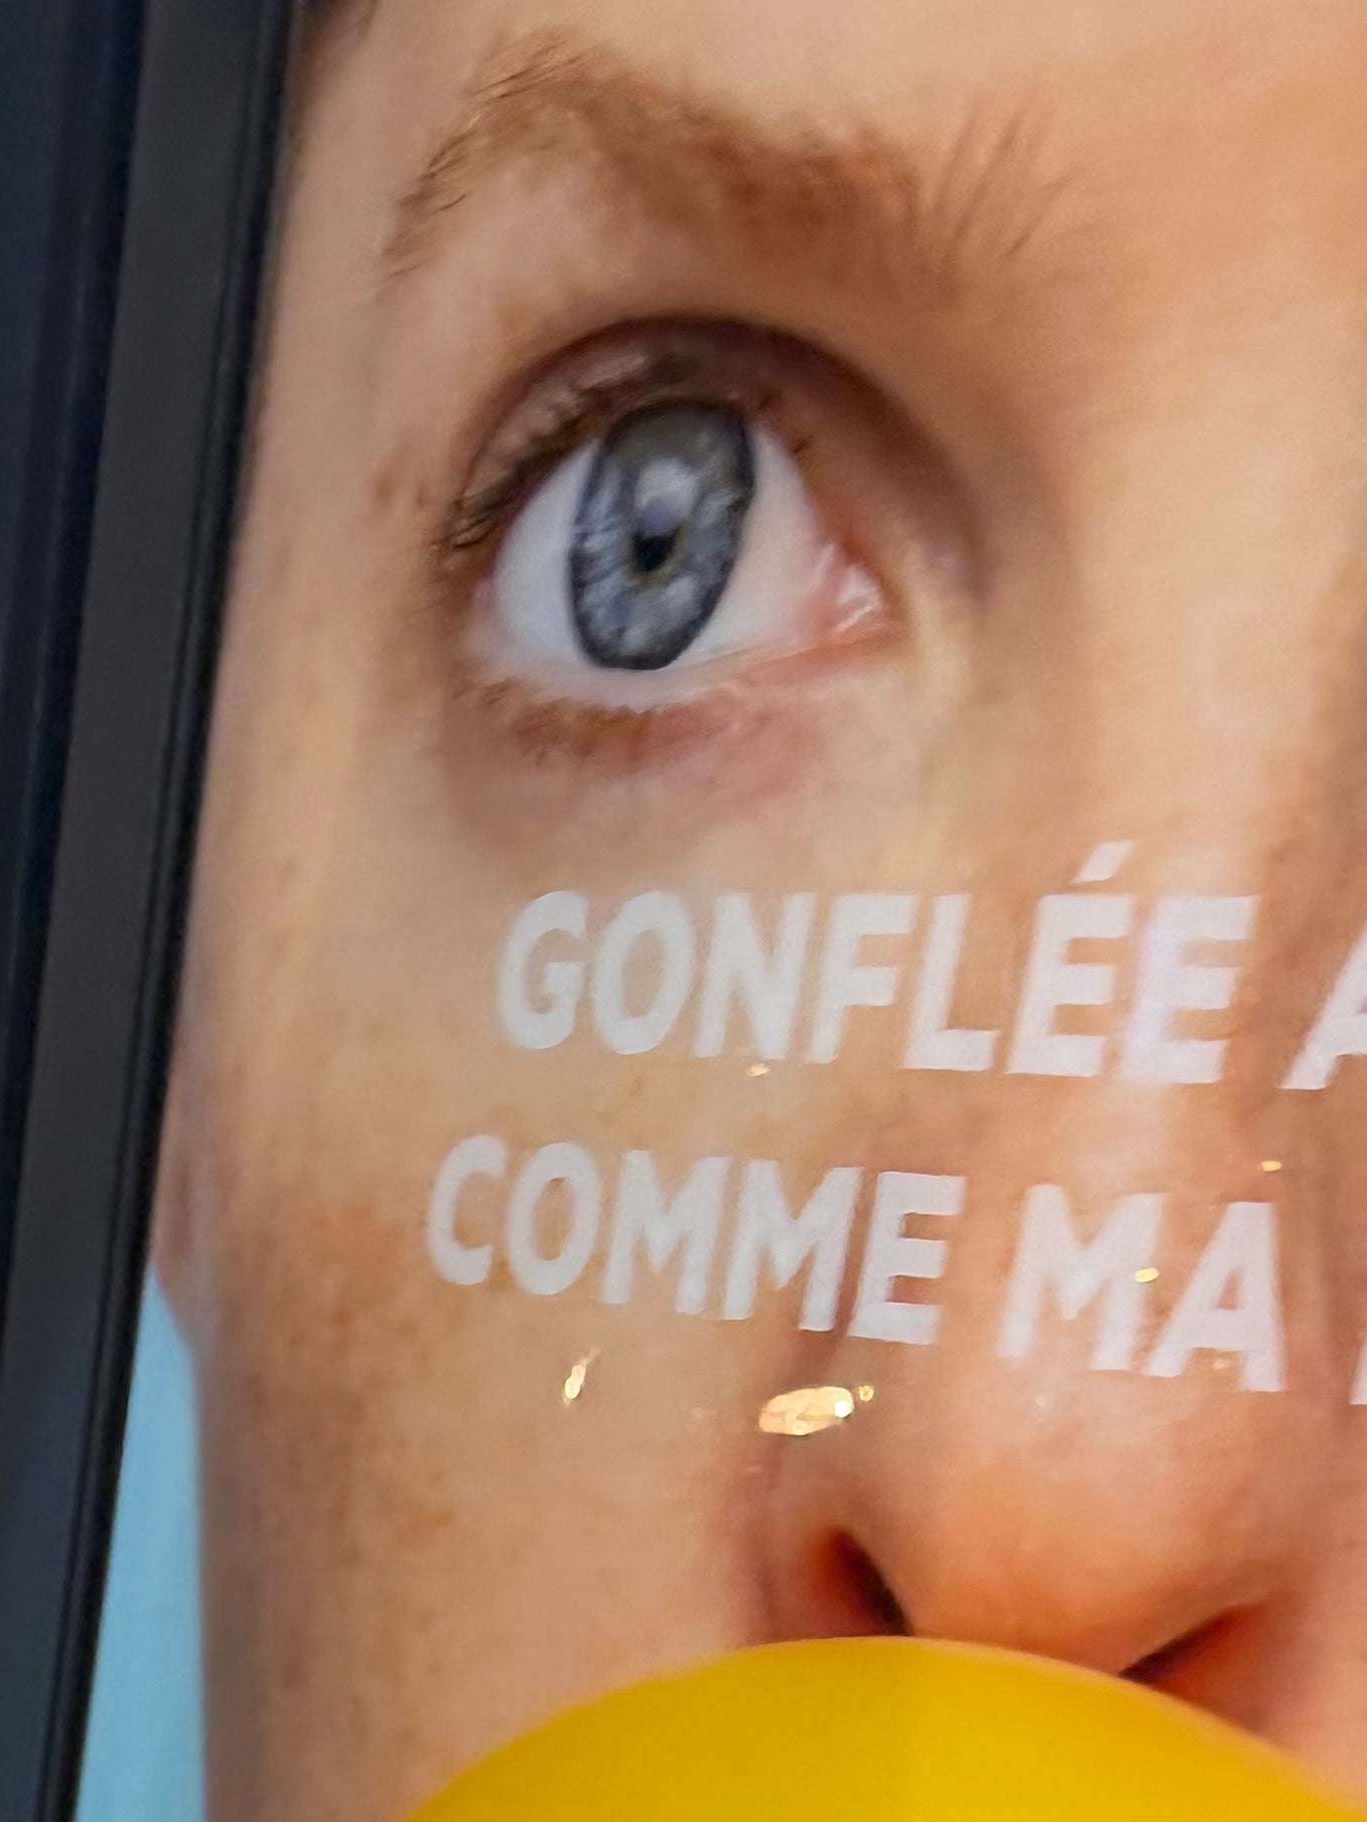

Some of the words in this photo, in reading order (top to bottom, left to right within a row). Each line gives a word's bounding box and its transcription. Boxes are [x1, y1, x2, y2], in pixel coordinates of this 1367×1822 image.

[498, 840, 1259, 1084] GONFLÉE
[425, 1134, 967, 1346] COMME
[996, 1182, 1287, 1392] MA
